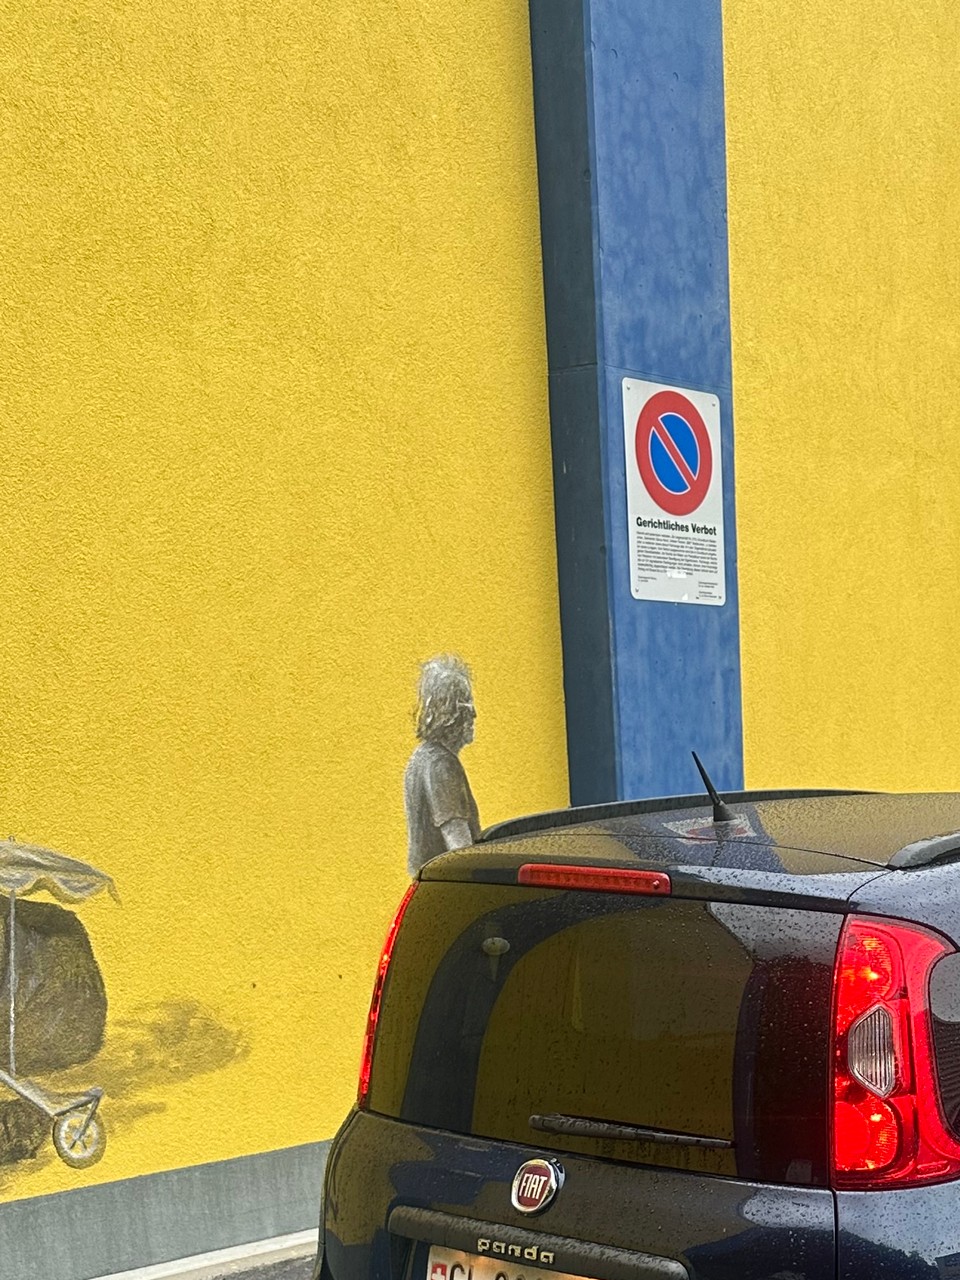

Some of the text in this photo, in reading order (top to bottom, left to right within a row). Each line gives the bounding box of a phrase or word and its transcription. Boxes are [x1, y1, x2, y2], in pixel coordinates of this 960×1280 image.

[636, 516, 717, 536] Gerichtliches Verbot
[518, 1173, 548, 1200] FIAT
[477, 1237, 555, 1264] panda
